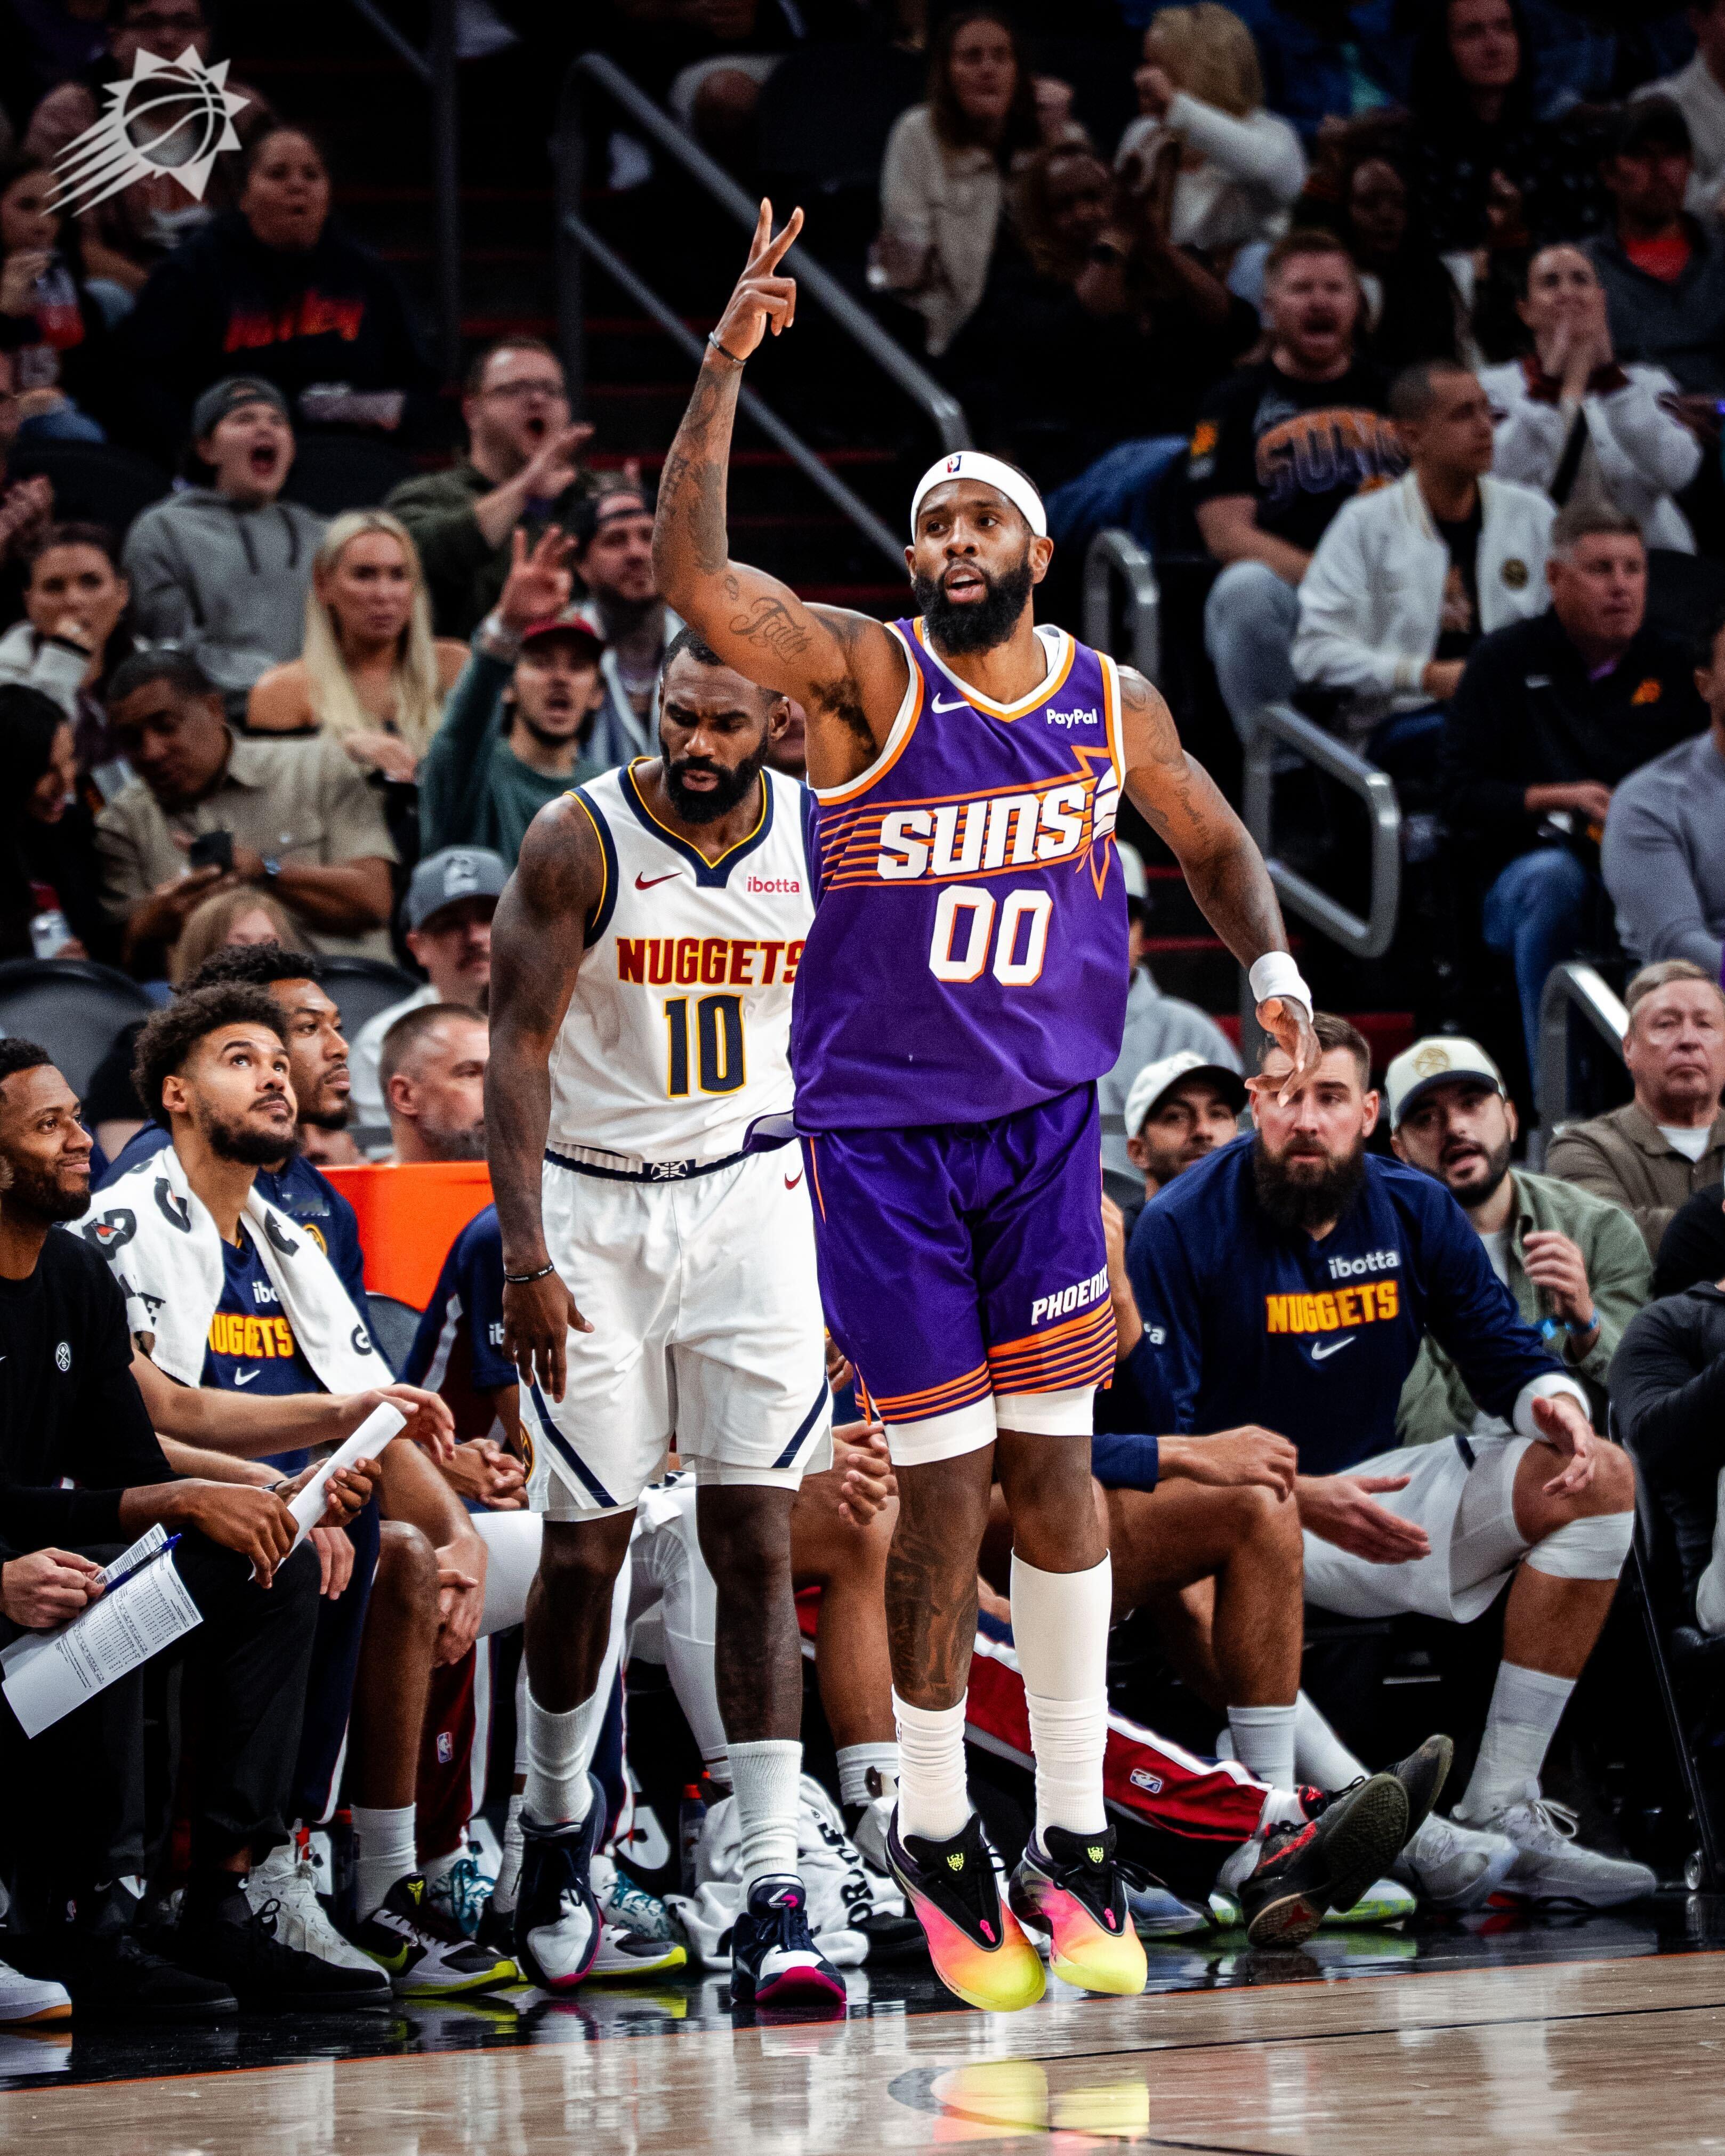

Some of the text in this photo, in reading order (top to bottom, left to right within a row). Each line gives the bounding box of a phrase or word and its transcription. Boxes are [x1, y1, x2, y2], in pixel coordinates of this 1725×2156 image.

[1046, 708, 1098, 729] PayPal
[877, 784, 1086, 879] SUNS
[747, 876, 800, 893] ibotta
[615, 938, 806, 986] NUGGETS
[929, 885, 1053, 986] 00
[663, 992, 746, 1098] 10
[1328, 1250, 1401, 1280] ibotta
[1031, 1263, 1109, 1326] PHOENIX
[1265, 1279, 1399, 1333] NUGGETS
